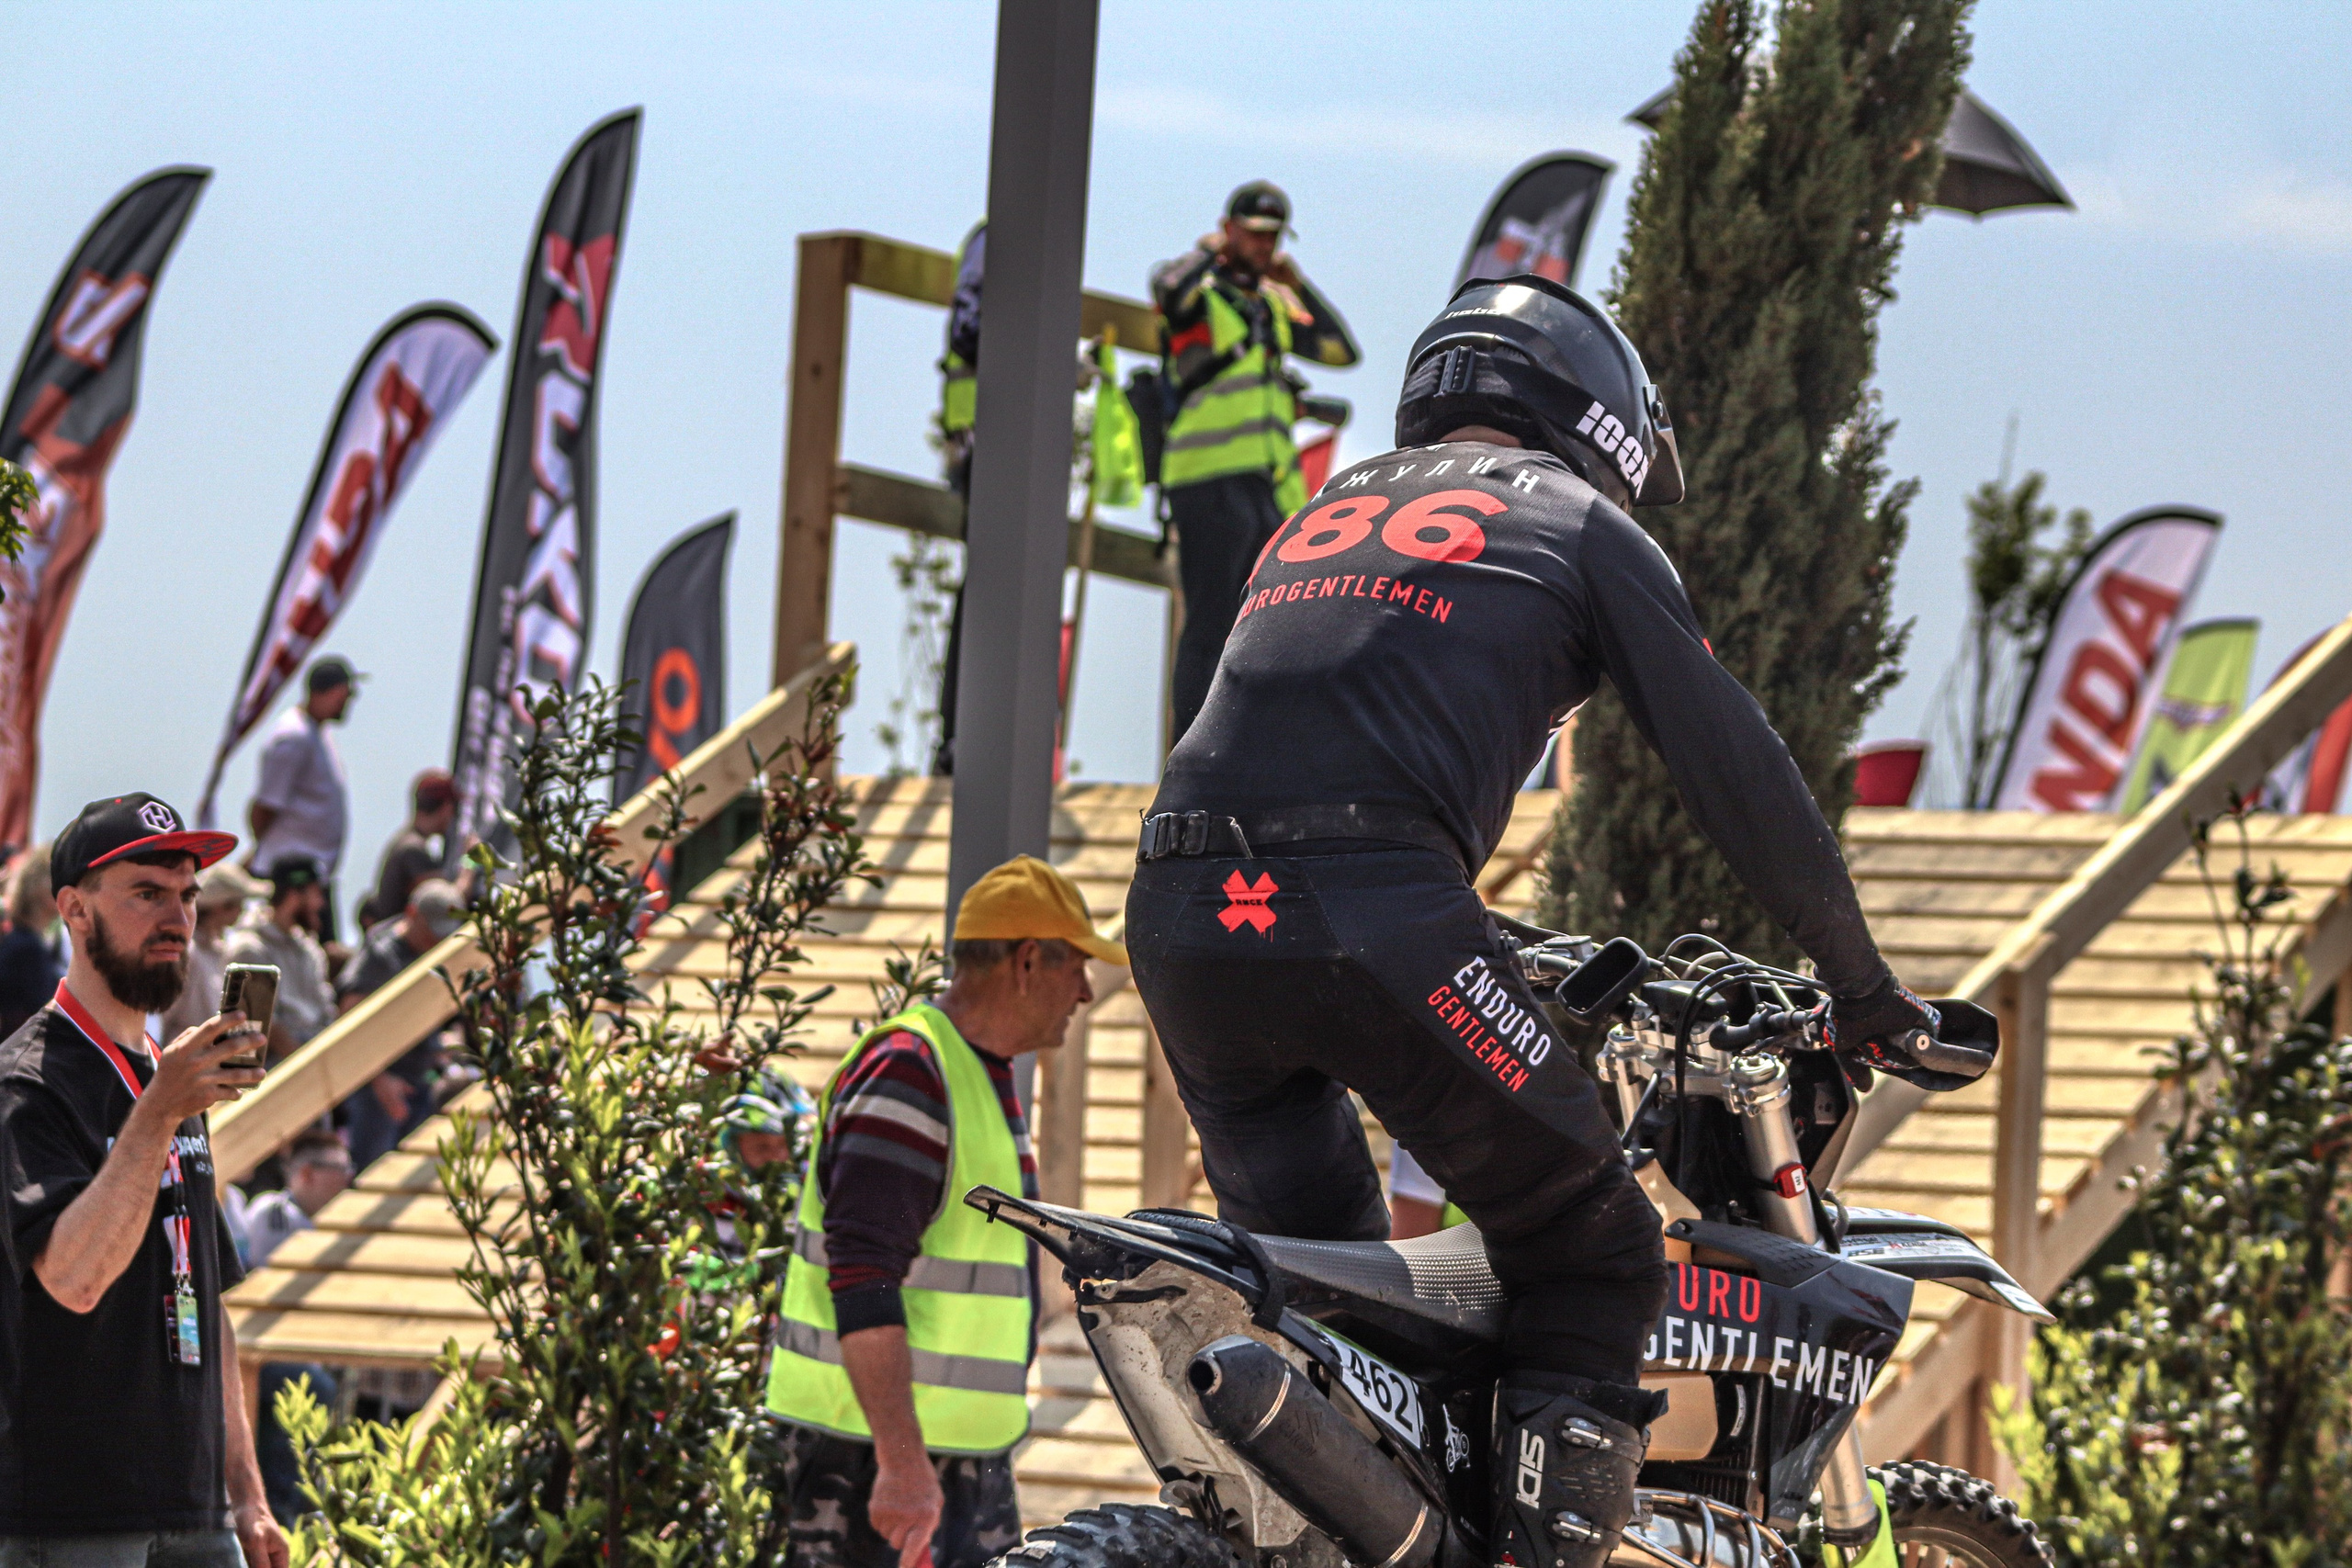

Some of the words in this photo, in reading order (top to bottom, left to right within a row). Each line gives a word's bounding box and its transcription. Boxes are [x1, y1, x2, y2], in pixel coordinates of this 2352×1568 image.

[1248, 489, 1509, 588] 86
[1427, 985, 1531, 1093] GENTLEMEN
[1453, 956, 1553, 1066] ENDURO
